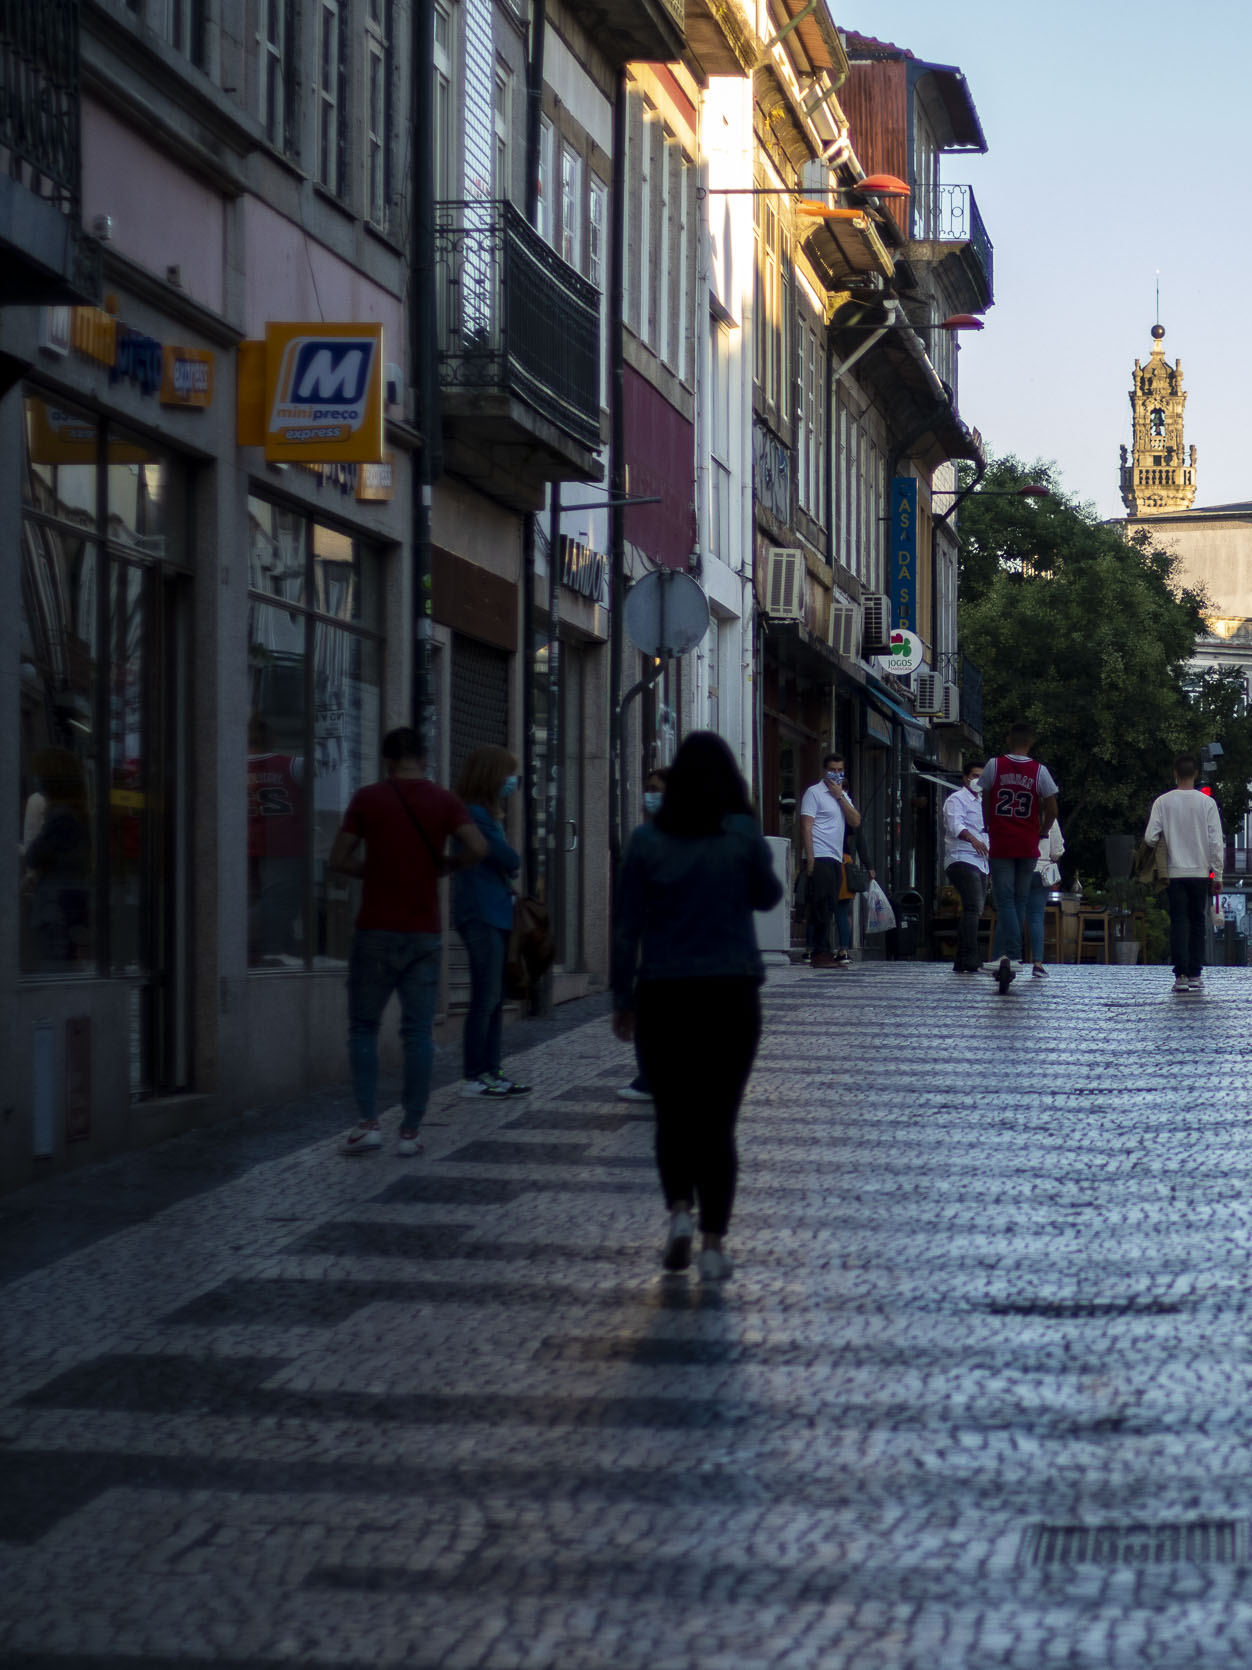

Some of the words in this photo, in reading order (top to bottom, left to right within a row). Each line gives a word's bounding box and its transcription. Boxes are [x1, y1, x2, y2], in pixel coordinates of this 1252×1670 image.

[297, 349, 363, 398] M
[277, 406, 359, 421] minipreço
[285, 425, 342, 441] express
[888, 659, 912, 669] JOGOS
[995, 788, 1033, 818] 23
